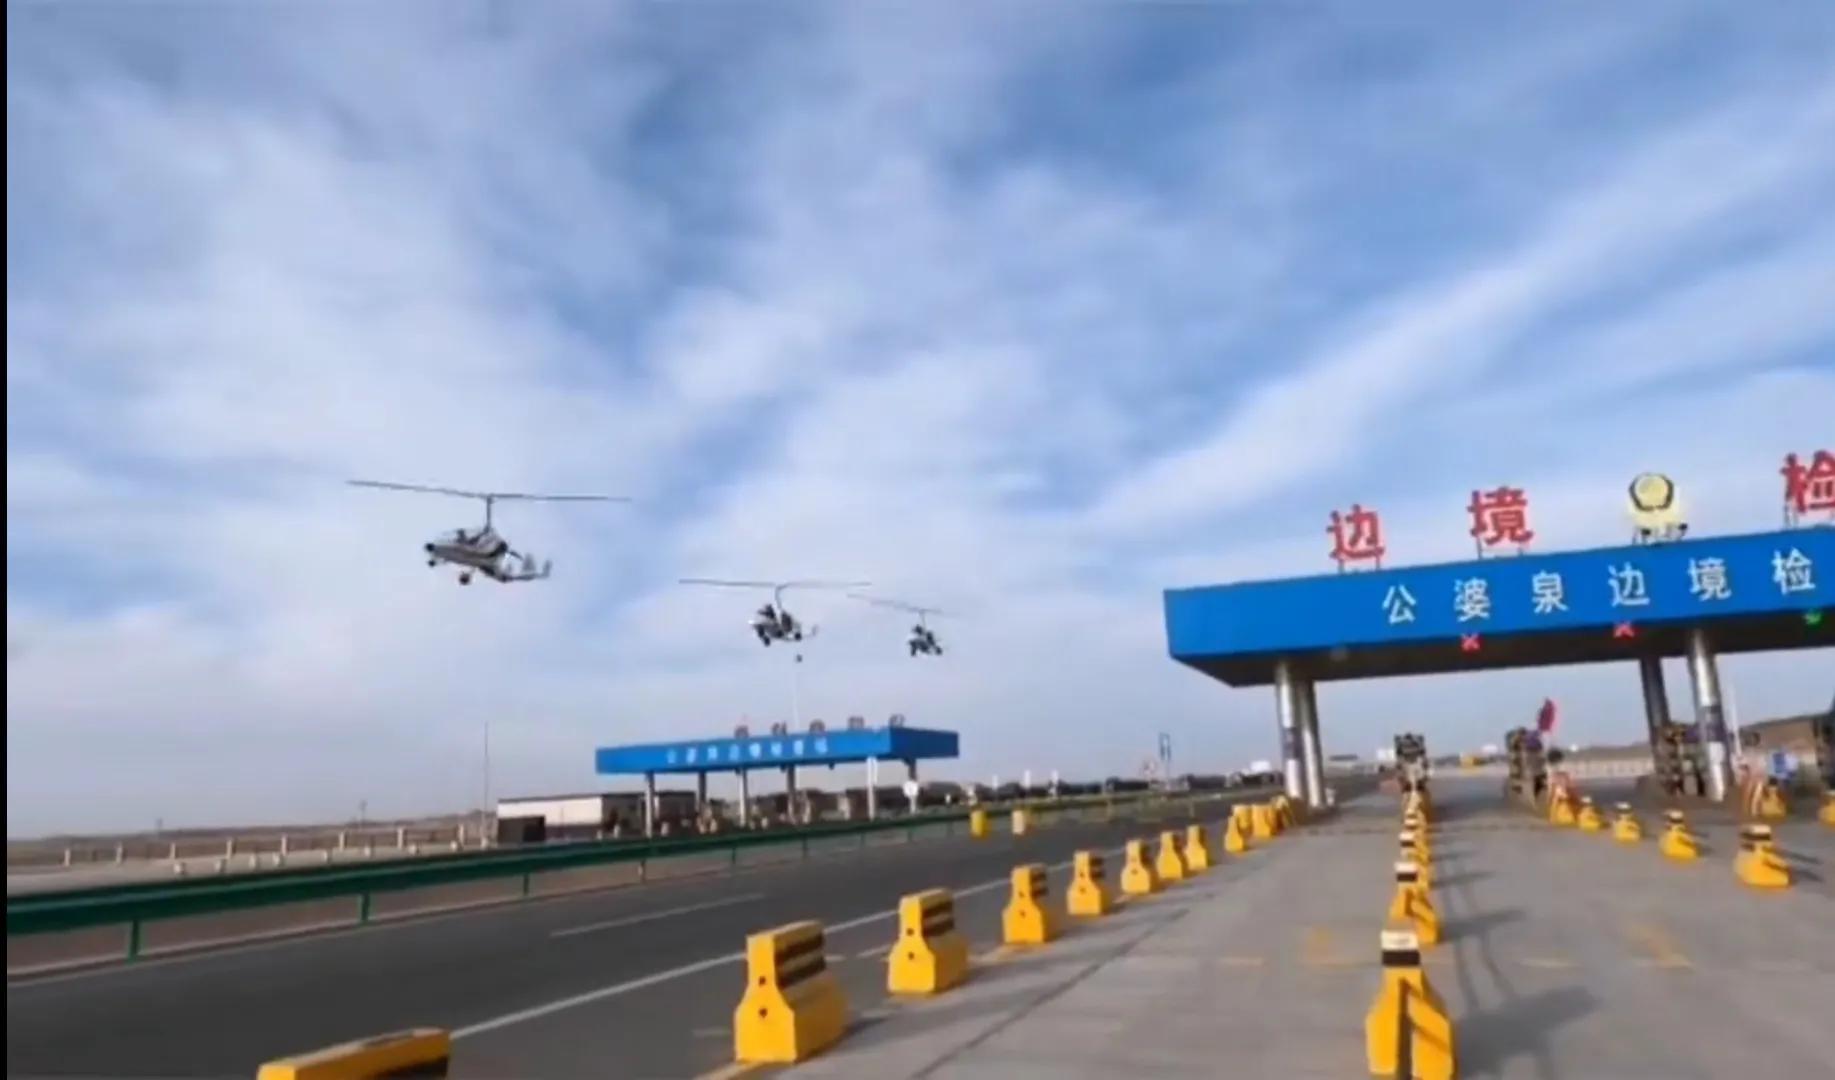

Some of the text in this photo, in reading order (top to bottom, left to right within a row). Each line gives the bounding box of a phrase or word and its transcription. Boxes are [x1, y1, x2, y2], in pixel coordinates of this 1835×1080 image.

[1381, 547, 1816, 625] 公婆泉边境检
